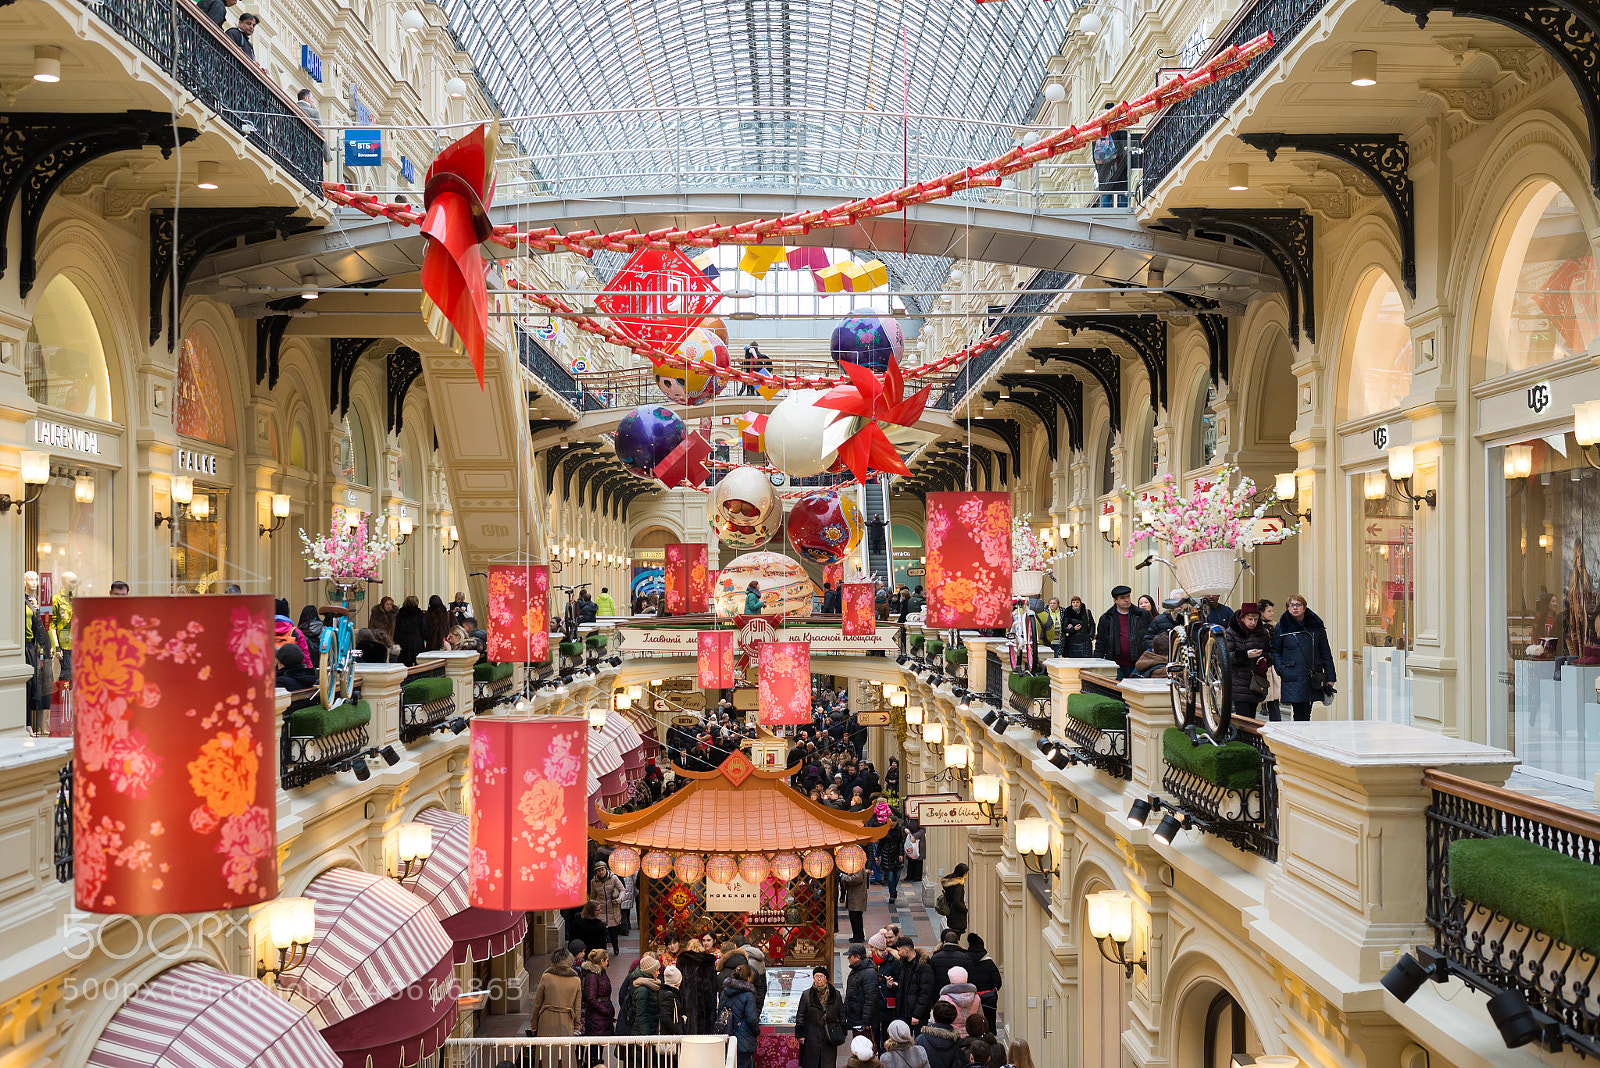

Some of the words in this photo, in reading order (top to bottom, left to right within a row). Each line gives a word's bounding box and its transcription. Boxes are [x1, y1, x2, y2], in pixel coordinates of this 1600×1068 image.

[1527, 384, 1550, 414] UGG
[34, 420, 74, 450] LAUREN
[73, 427, 102, 455] VIDAL
[1373, 427, 1388, 450] UGG
[178, 449, 217, 476] FALKE
[749, 619, 767, 633] ГУМ
[642, 632, 682, 644] Главный
[802, 632, 841, 642] Красной
[842, 634, 883, 644] площади
